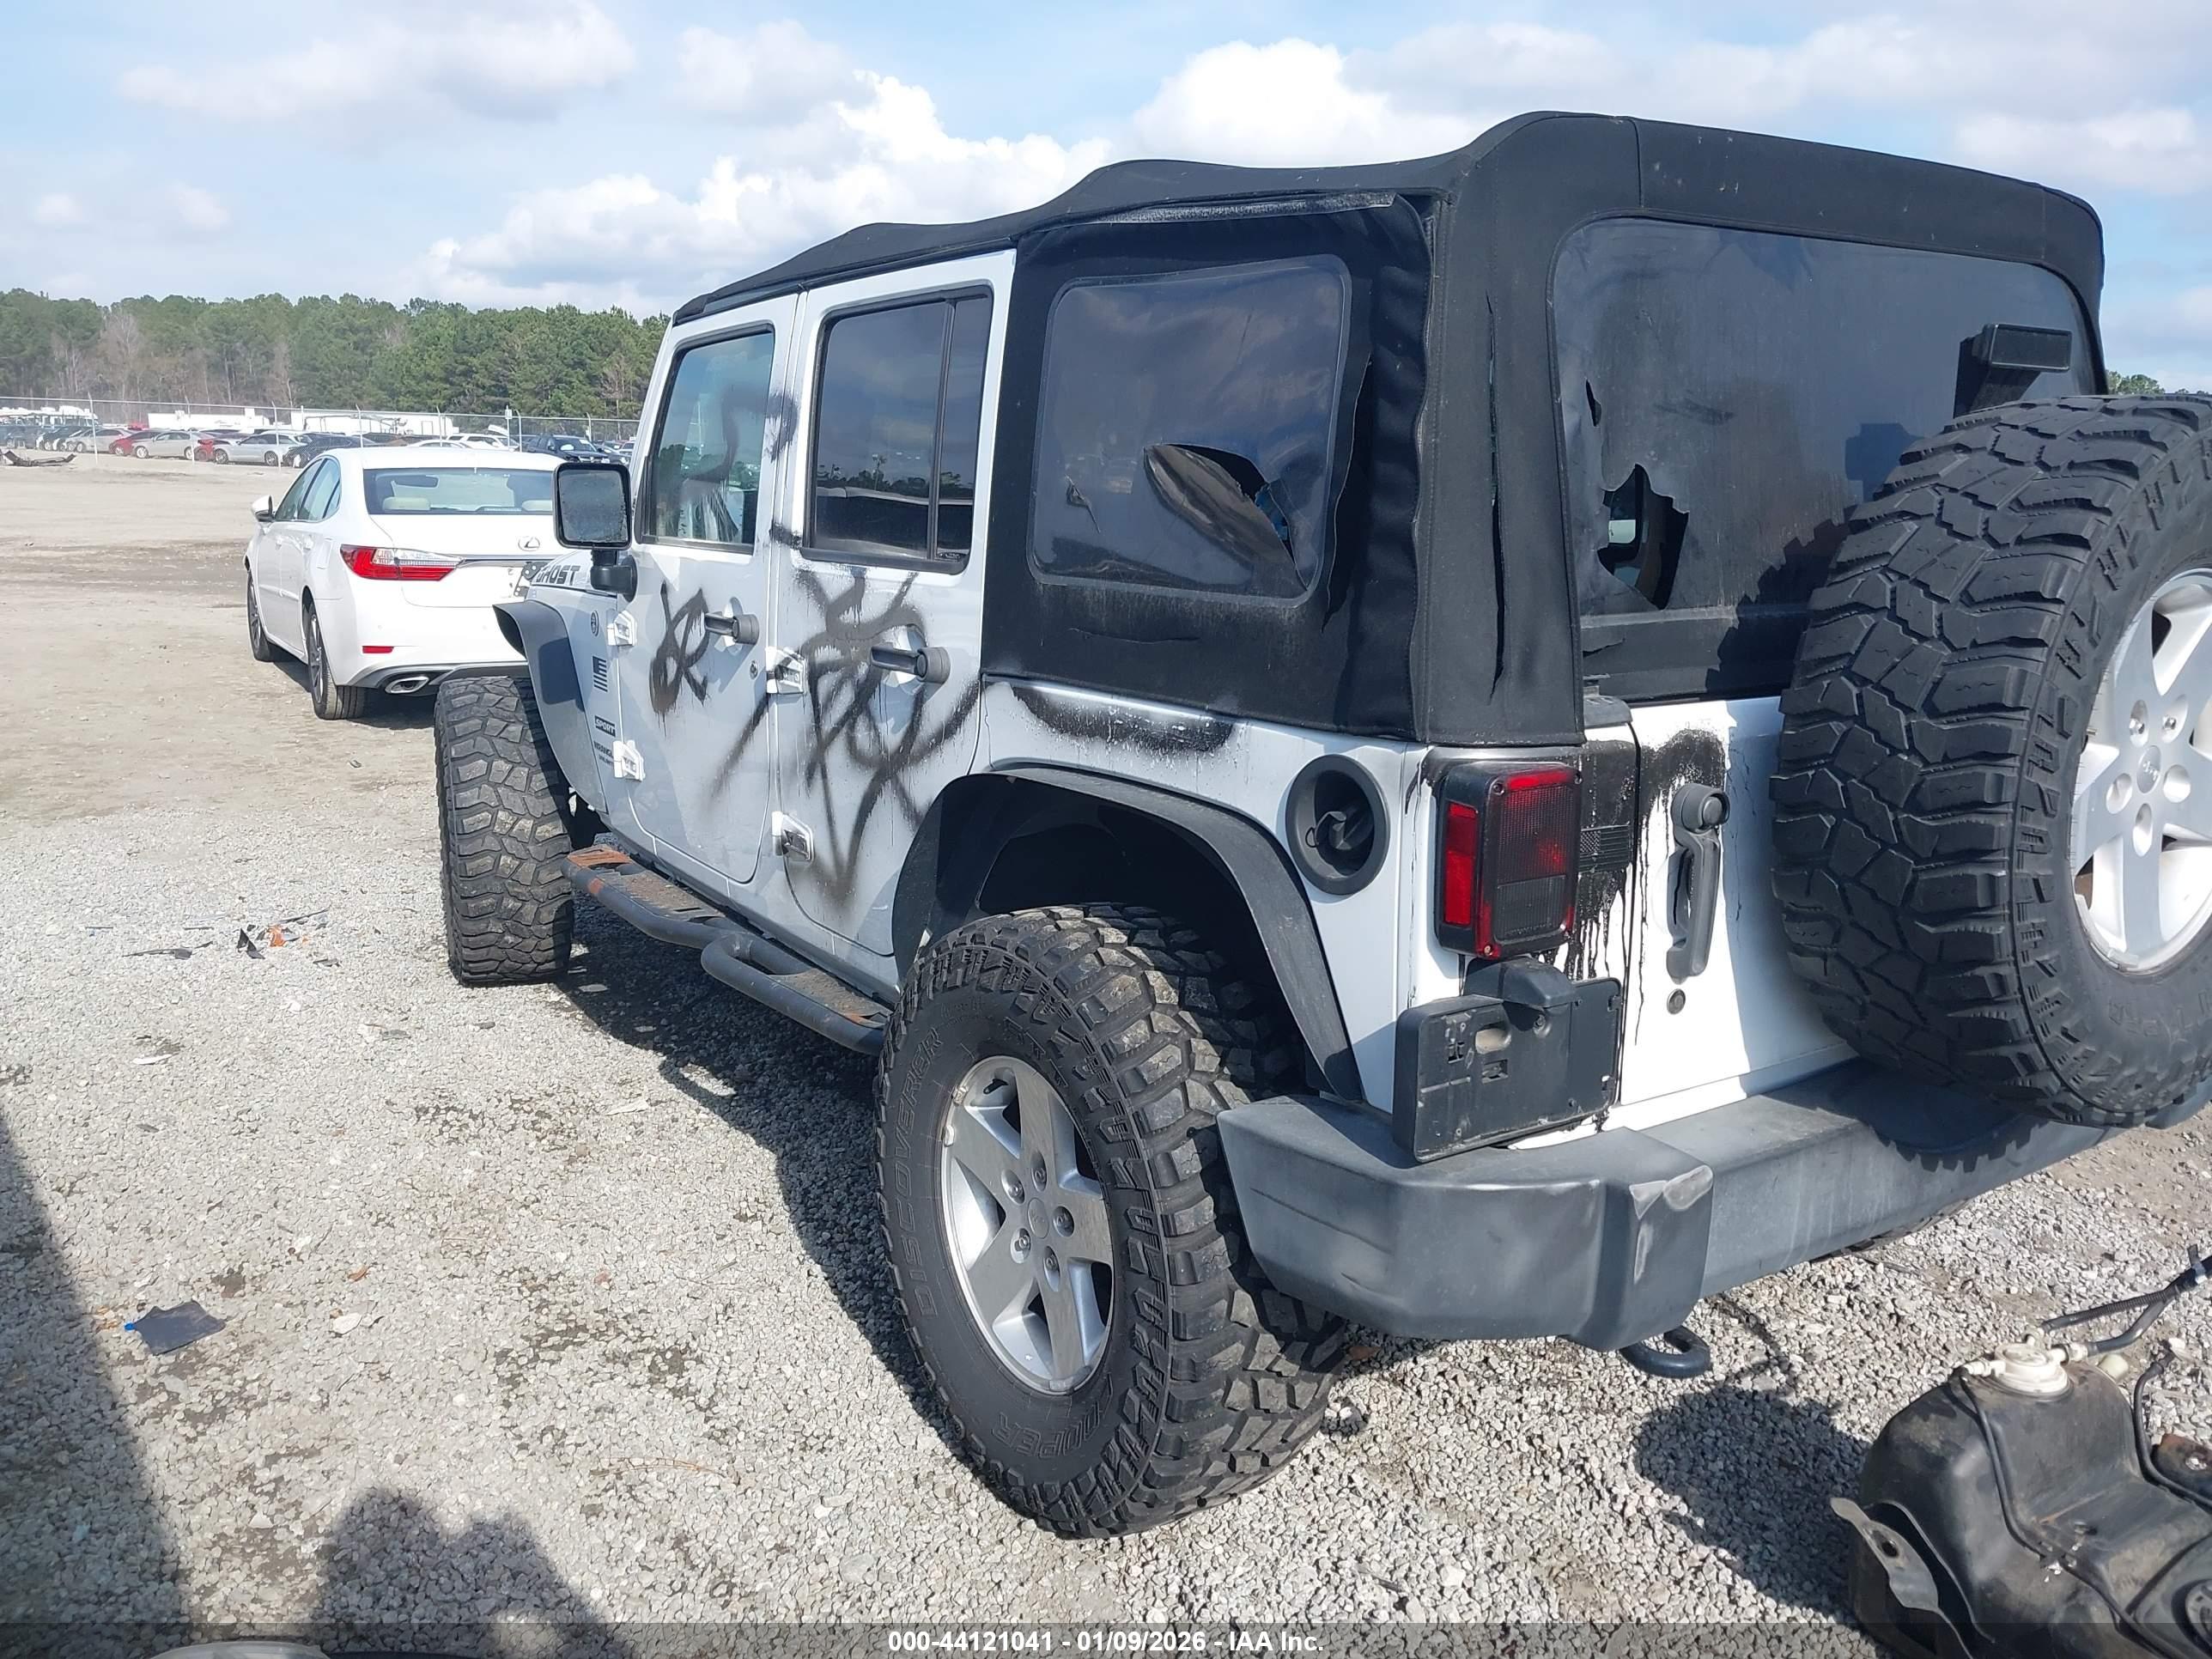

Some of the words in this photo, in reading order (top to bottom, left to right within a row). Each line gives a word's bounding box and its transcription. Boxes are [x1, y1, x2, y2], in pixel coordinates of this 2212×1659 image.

[595, 718, 616, 736] SPORT
[894, 1024, 944, 1316] DISCOVERER
[990, 1371, 1113, 1458] COOPER
